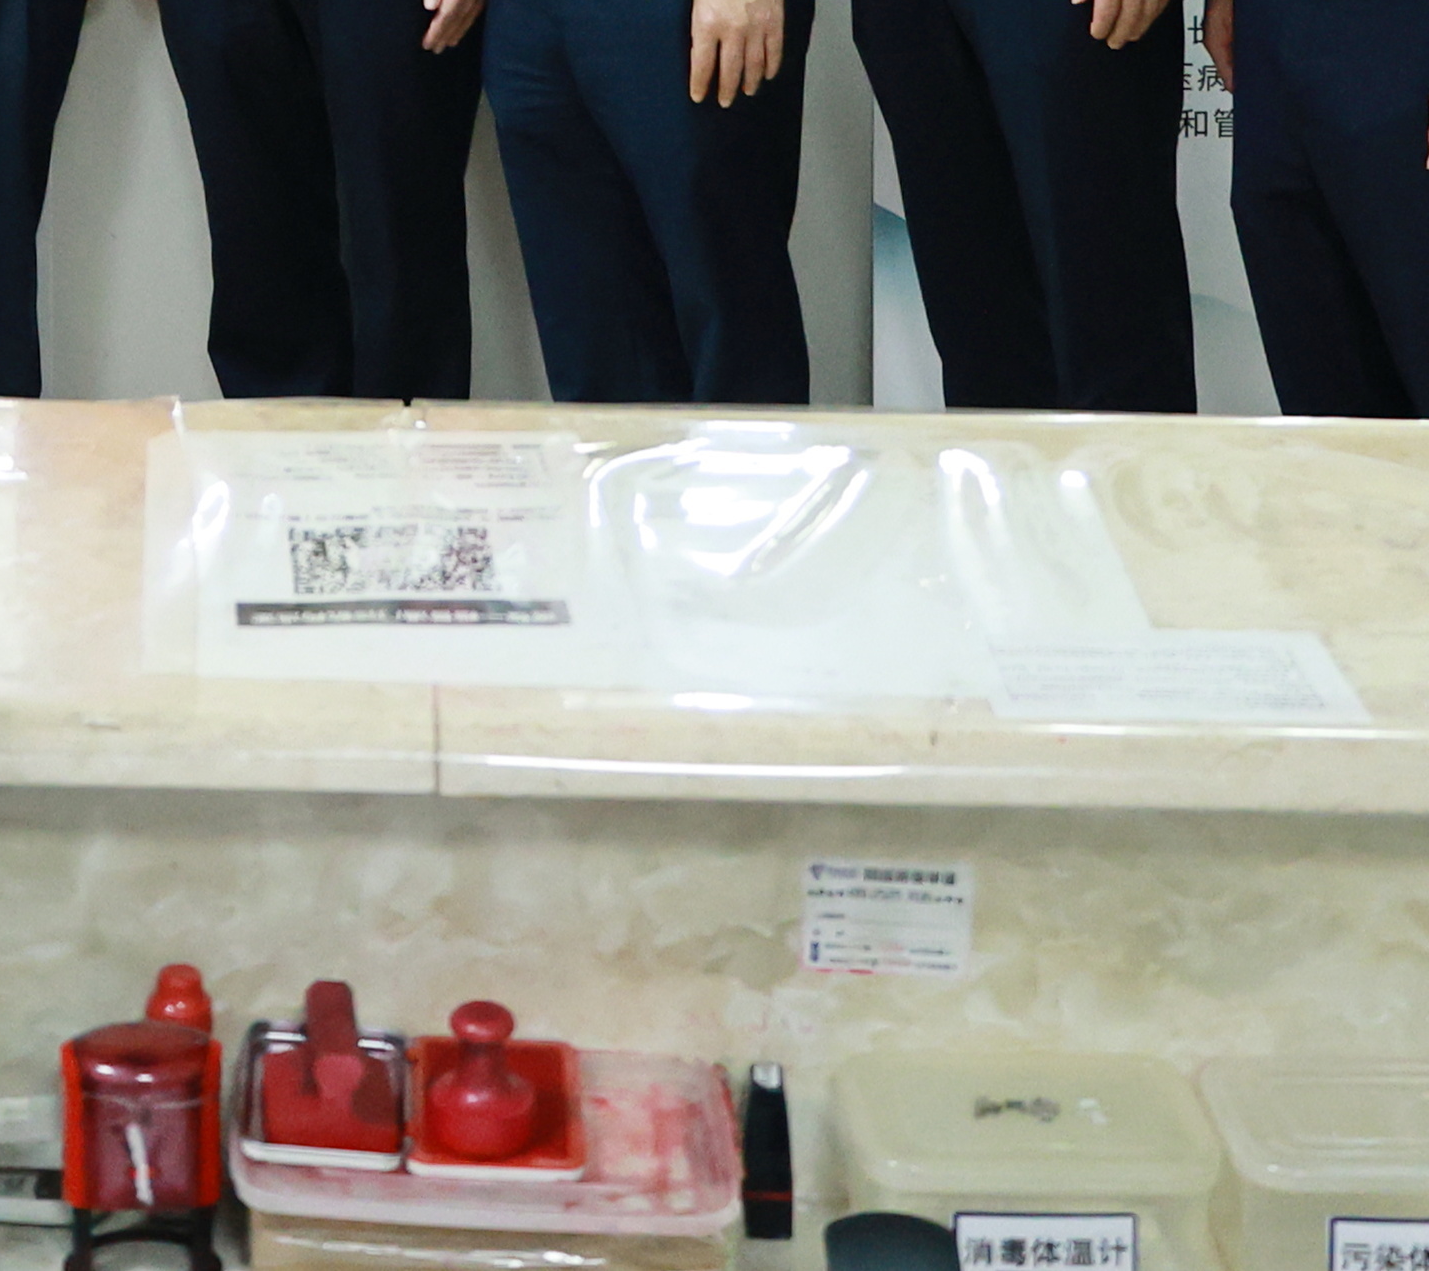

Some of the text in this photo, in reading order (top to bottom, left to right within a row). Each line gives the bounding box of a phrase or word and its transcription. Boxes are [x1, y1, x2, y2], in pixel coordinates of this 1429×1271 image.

[964, 1235, 1129, 1267] 消毒体温计
